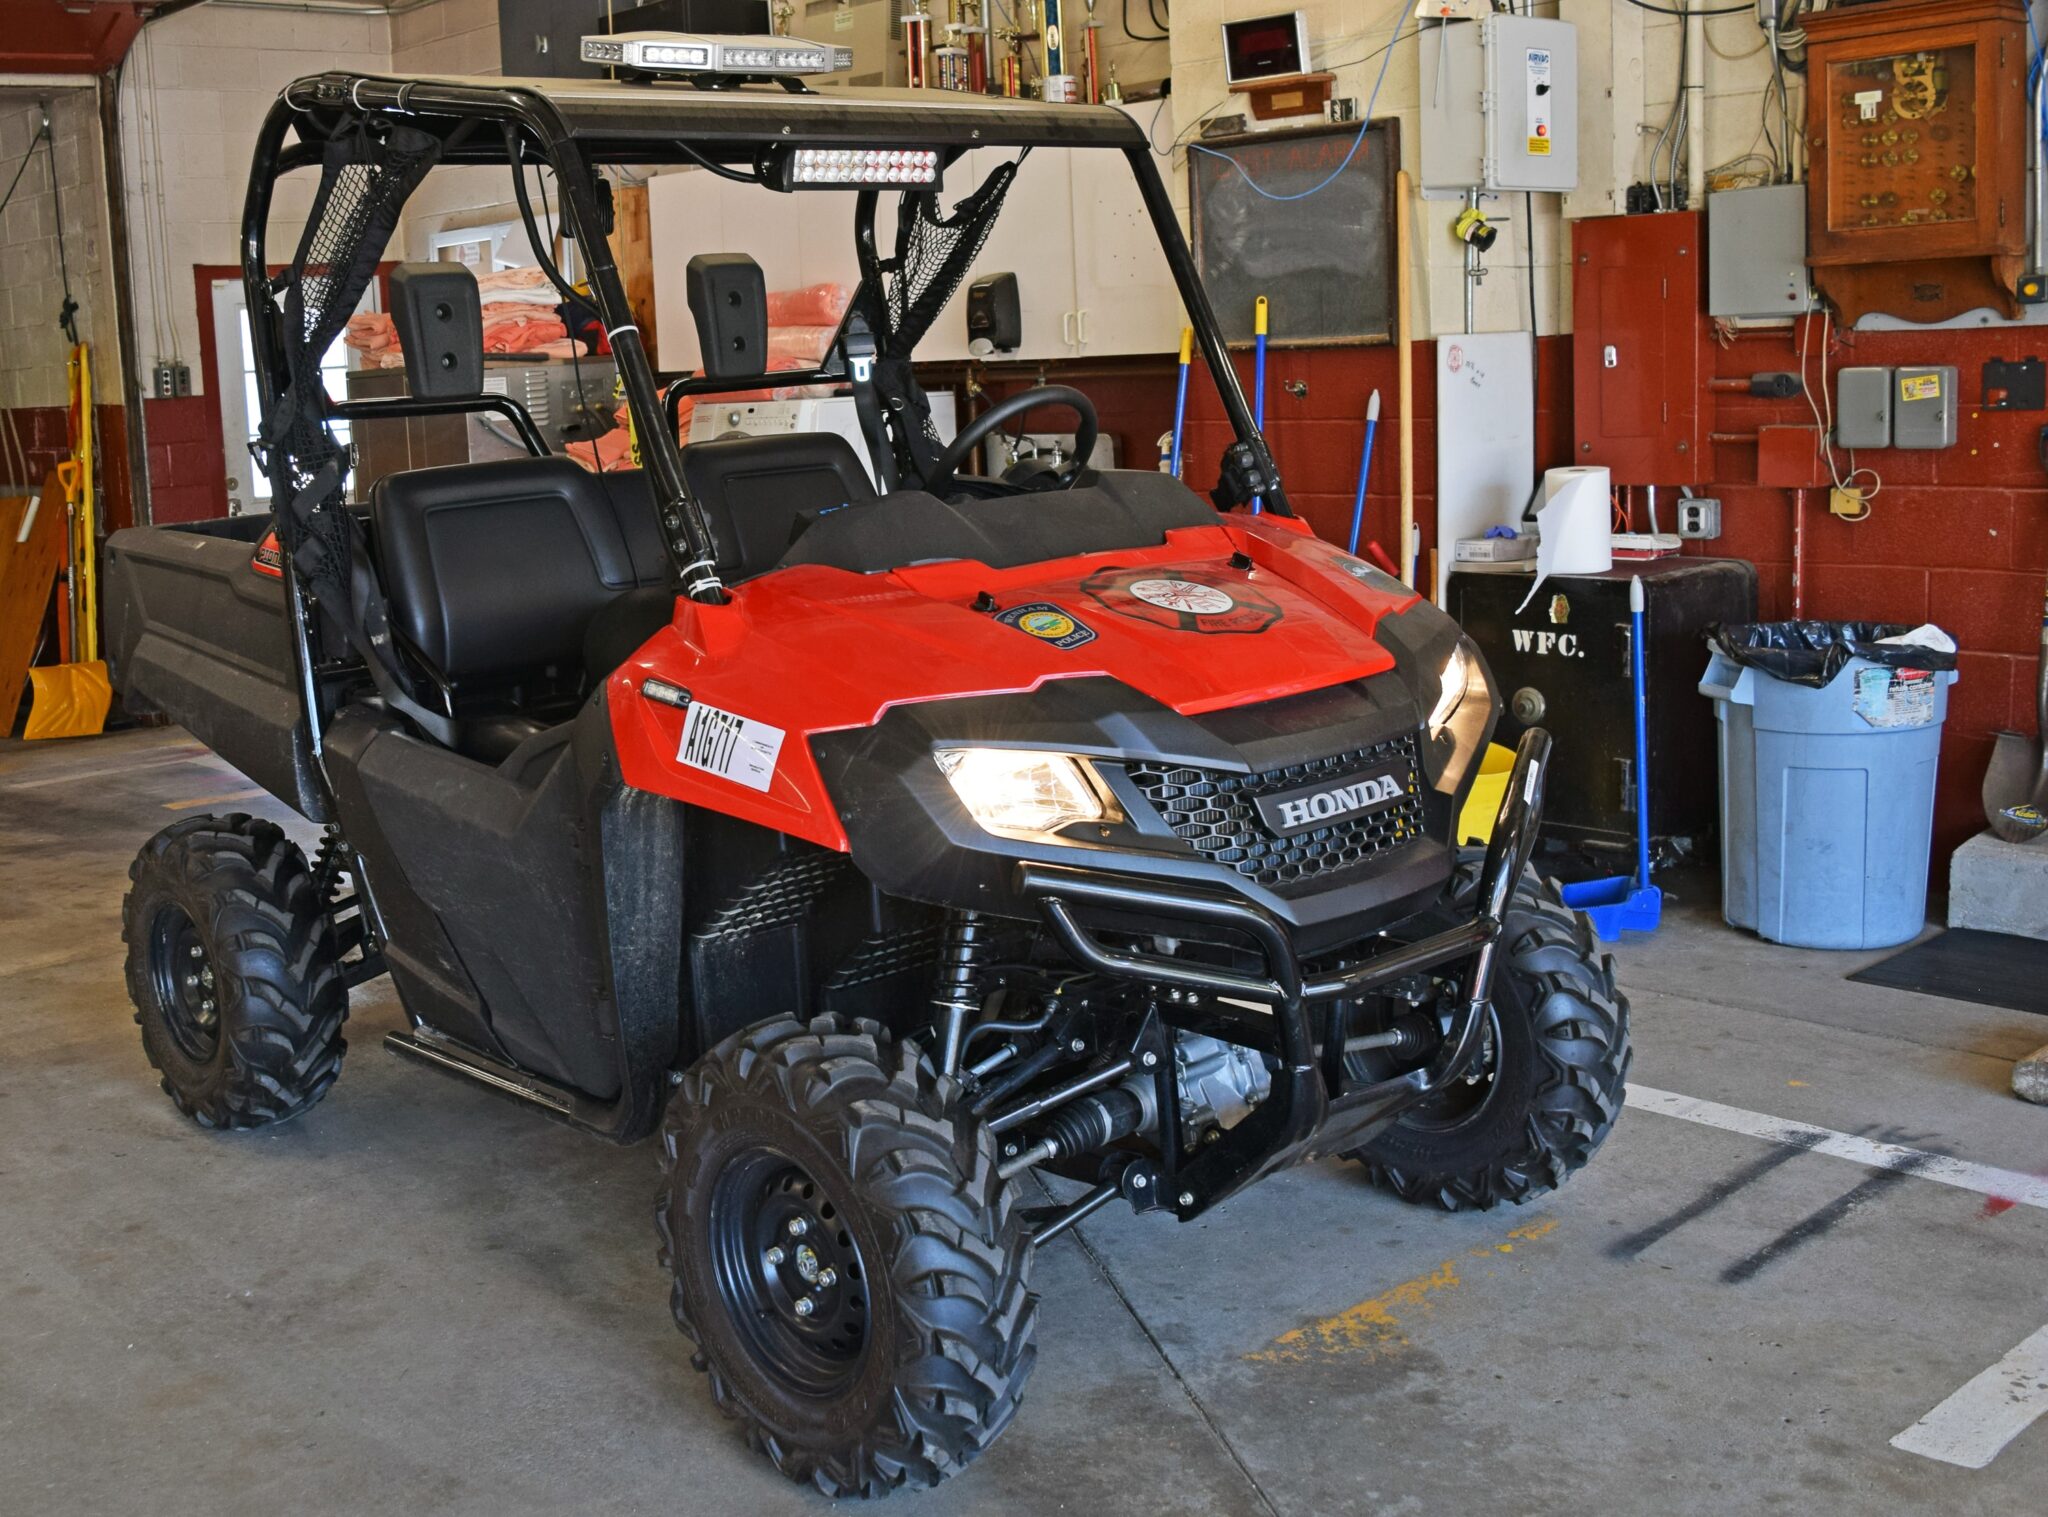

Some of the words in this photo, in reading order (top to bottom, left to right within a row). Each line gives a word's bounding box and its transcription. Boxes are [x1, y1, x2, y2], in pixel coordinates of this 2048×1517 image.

[1055, 629, 1091, 646] POLICE
[1511, 629, 1585, 658] WFC.
[684, 705, 744, 774] A1G717
[1278, 774, 1404, 828] HONDA
